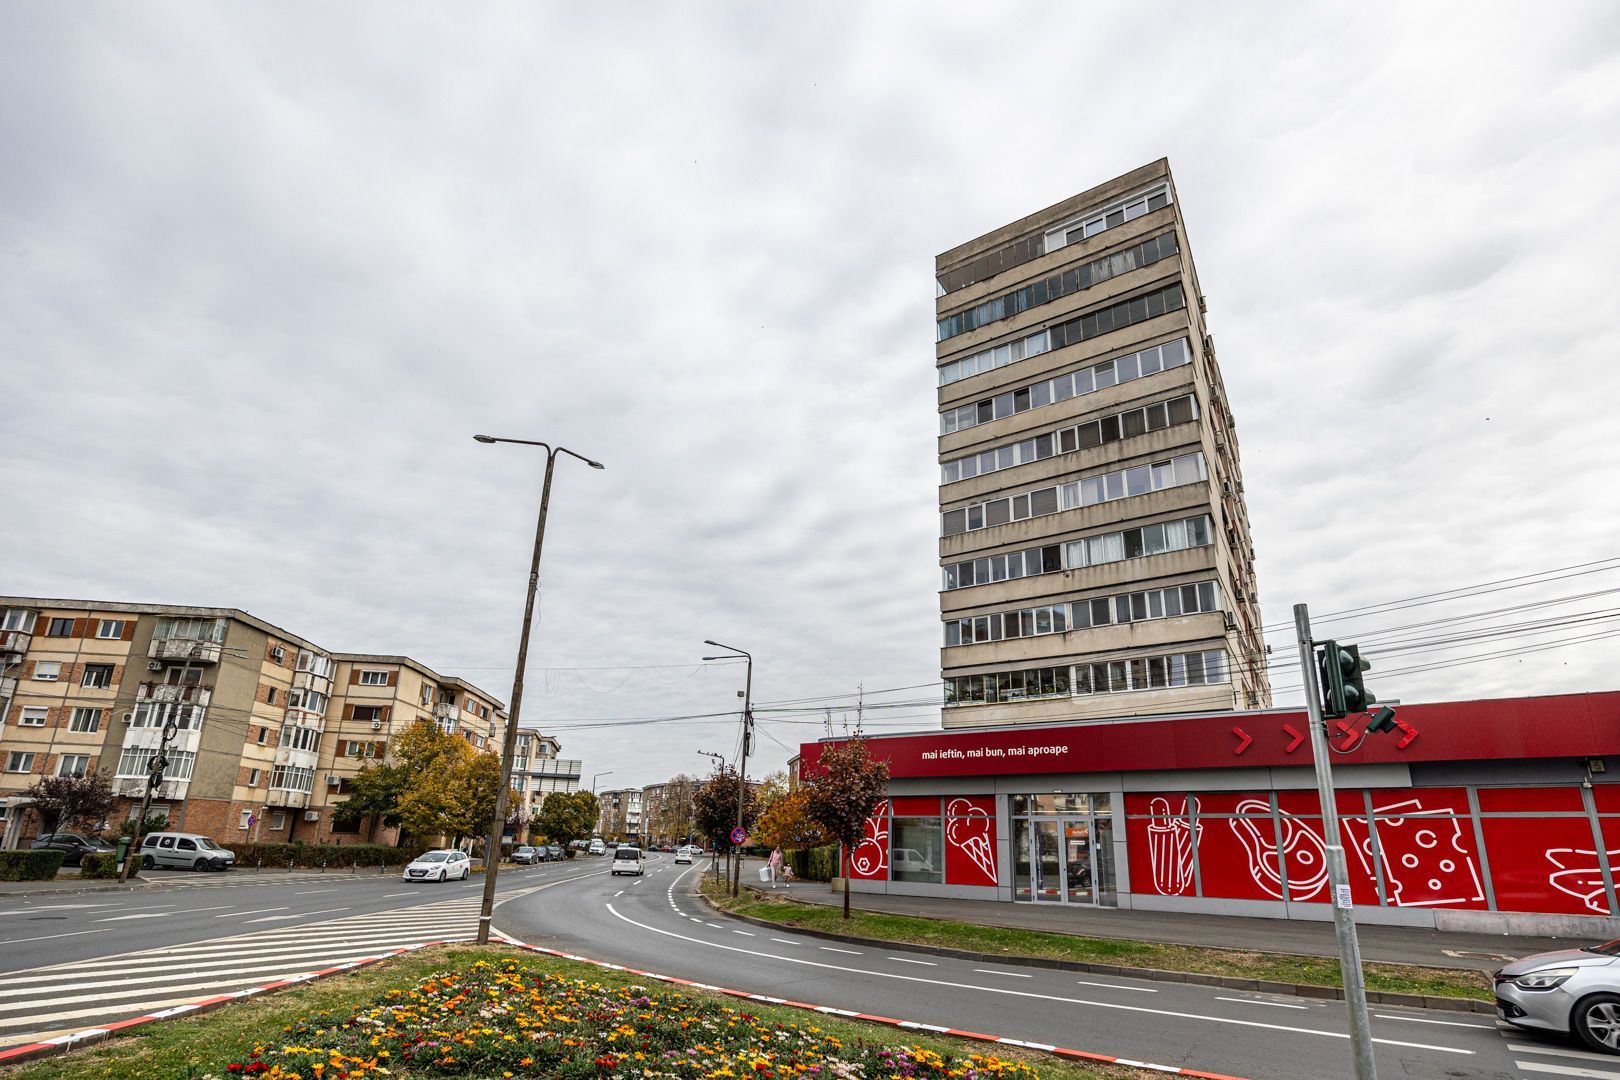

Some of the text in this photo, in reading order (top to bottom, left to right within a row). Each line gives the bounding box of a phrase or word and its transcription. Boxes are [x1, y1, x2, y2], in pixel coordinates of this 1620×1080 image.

[922, 745, 1068, 760] mai ieftin, mai bun, mai aproape
